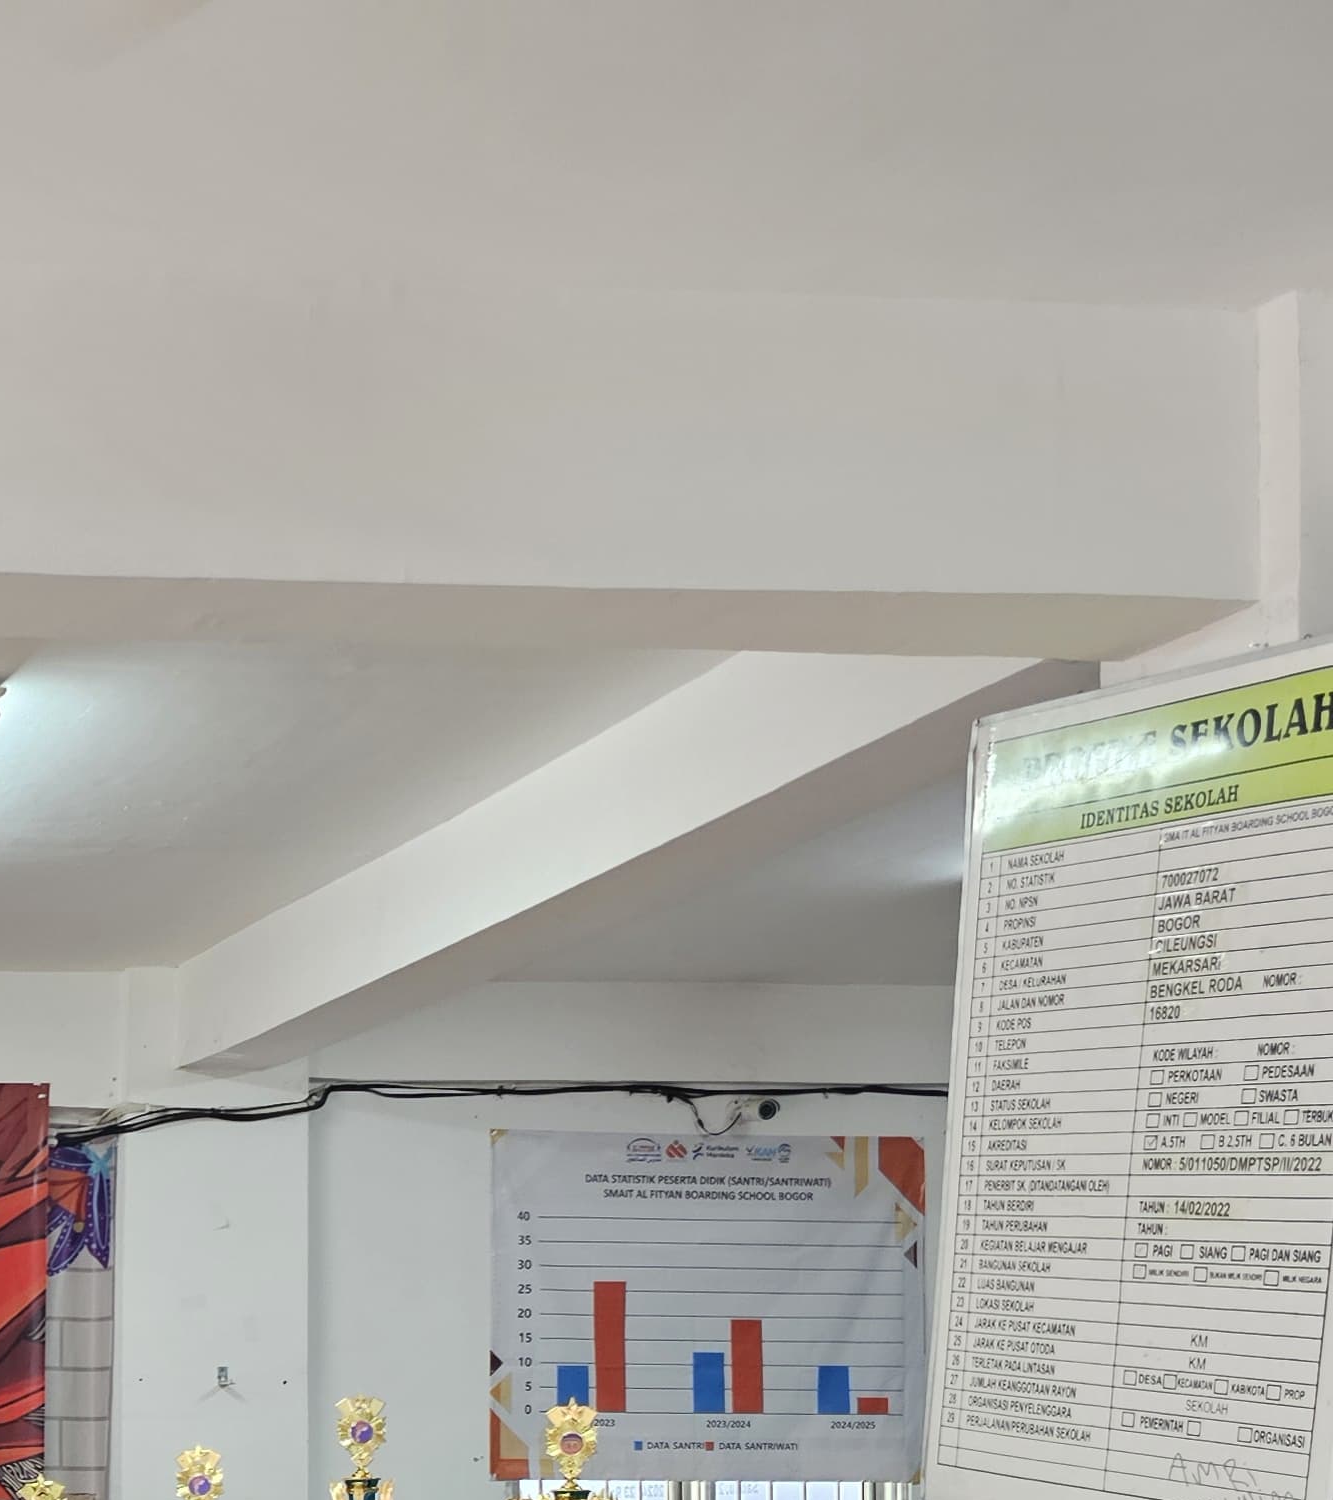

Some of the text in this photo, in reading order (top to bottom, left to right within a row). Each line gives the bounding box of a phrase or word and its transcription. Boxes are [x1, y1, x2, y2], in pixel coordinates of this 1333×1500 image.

[1081, 785, 1240, 830] IDENTITAS SEKOLAH
[1201, 824, 1229, 836] FITYAN
[1231, 816, 1273, 832] BOARDING
[1275, 810, 1309, 824] SCHOOL
[1008, 851, 1065, 870] NAMA SEKOLAH
[1020, 872, 1055, 888] STATISTIK
[1162, 867, 1219, 888] 700027072
[1158, 888, 1236, 910] JAWA BARAT
[1004, 917, 1037, 930] PROPINSI
[1158, 915, 1201, 933] BOGOR
[1002, 936, 1044, 951] KABUPATEN
[1001, 957, 1044, 971] KECAMATAN
[1023, 974, 1067, 988] KELURAHAN
[1150, 976, 1243, 999] BENGKEL RODA
[997, 994, 1065, 1011] JALAN DAN NOMOR
[1150, 1005, 1180, 1020] 16820
[997, 1018, 1032, 1031] KODE POS
[995, 1038, 1027, 1051] TELEPON
[1153, 1047, 1213, 1062] KODE WILAYAH
[1168, 1069, 1223, 1082] PERKOTAAN
[1262, 1064, 1315, 1079] PEDESAAN
[991, 1079, 1021, 1092] DAERAH
[1166, 1091, 1199, 1104] NEGERI
[1258, 1089, 1298, 1102] SWASTA
[990, 1098, 1051, 1112] STATUS SEKOLAH
[1163, 1114, 1180, 1126] INTI
[1200, 1113, 1230, 1126] MODEL
[1252, 1111, 1280, 1124] FILIAL
[989, 1118, 1062, 1131] KELOMPOK SEKOLAH
[987, 1139, 1027, 1151] AKREDITASI
[1298, 1133, 1332, 1147] BULAN
[986, 1159, 1066, 1172] SURAT KEPUTUSAN SK
[585, 1174, 832, 1189] DATA STATISTIK PESERTA DIDIK (SANTRI/SANTRIWATI)
[603, 1189, 813, 1202] SMAIT AL FITYAN BOARDING SCHOOL BOGOR
[984, 1200, 1034, 1212] TAHUN BERDIRI
[1174, 1201, 1231, 1217] 14/02/2022
[517, 1211, 531, 1222] 40
[982, 1219, 1047, 1232] TAHUN PERUBAHAN
[517, 1236, 532, 1246] 35
[980, 1240, 1087, 1254] KEGIATAN BELAJAR MENGAJAR
[1152, 1244, 1173, 1257] PAGI
[1199, 1246, 1228, 1259] SIANG
[1249, 1248, 1321, 1263] PAGI DAN SIANG
[517, 1260, 532, 1270] 30
[978, 1259, 1051, 1273] BANGUNAN SEKOLAH
[517, 1284, 532, 1294] 25
[977, 1278, 1035, 1292] LUAS BANGUNAN
[976, 1298, 1034, 1312] LOKASI SEKOLAH
[517, 1308, 532, 1318] 20
[974, 1318, 1076, 1336] JARAK KE PUSAT KECAMATAN
[517, 1333, 532, 1343] 15
[1190, 1335, 1208, 1348] KM
[517, 1357, 532, 1367] 10
[1188, 1357, 1206, 1369] KM
[1138, 1374, 1162, 1386] DESA
[1177, 1377, 1213, 1390] KECAMATAN
[525, 1382, 532, 1392] 5
[524, 1405, 532, 1415] 0
[968, 1395, 1071, 1418] ORGANISASI PENYELENGGARA
[1185, 1400, 1228, 1415] SEKOLAH
[706, 1419, 751, 1430] 2023/2024
[831, 1420, 876, 1431] 2024/2025
[966, 1414, 1091, 1442] PERJALANAN PERUBAHAN SEKOLAH
[1140, 1416, 1183, 1432] PEMERINTAH
[646, 1441, 704, 1451] DATA SANTRI
[1254, 1431, 1305, 1449] ORGANISASI
[719, 1442, 798, 1452] DATA SANTRIWATI
